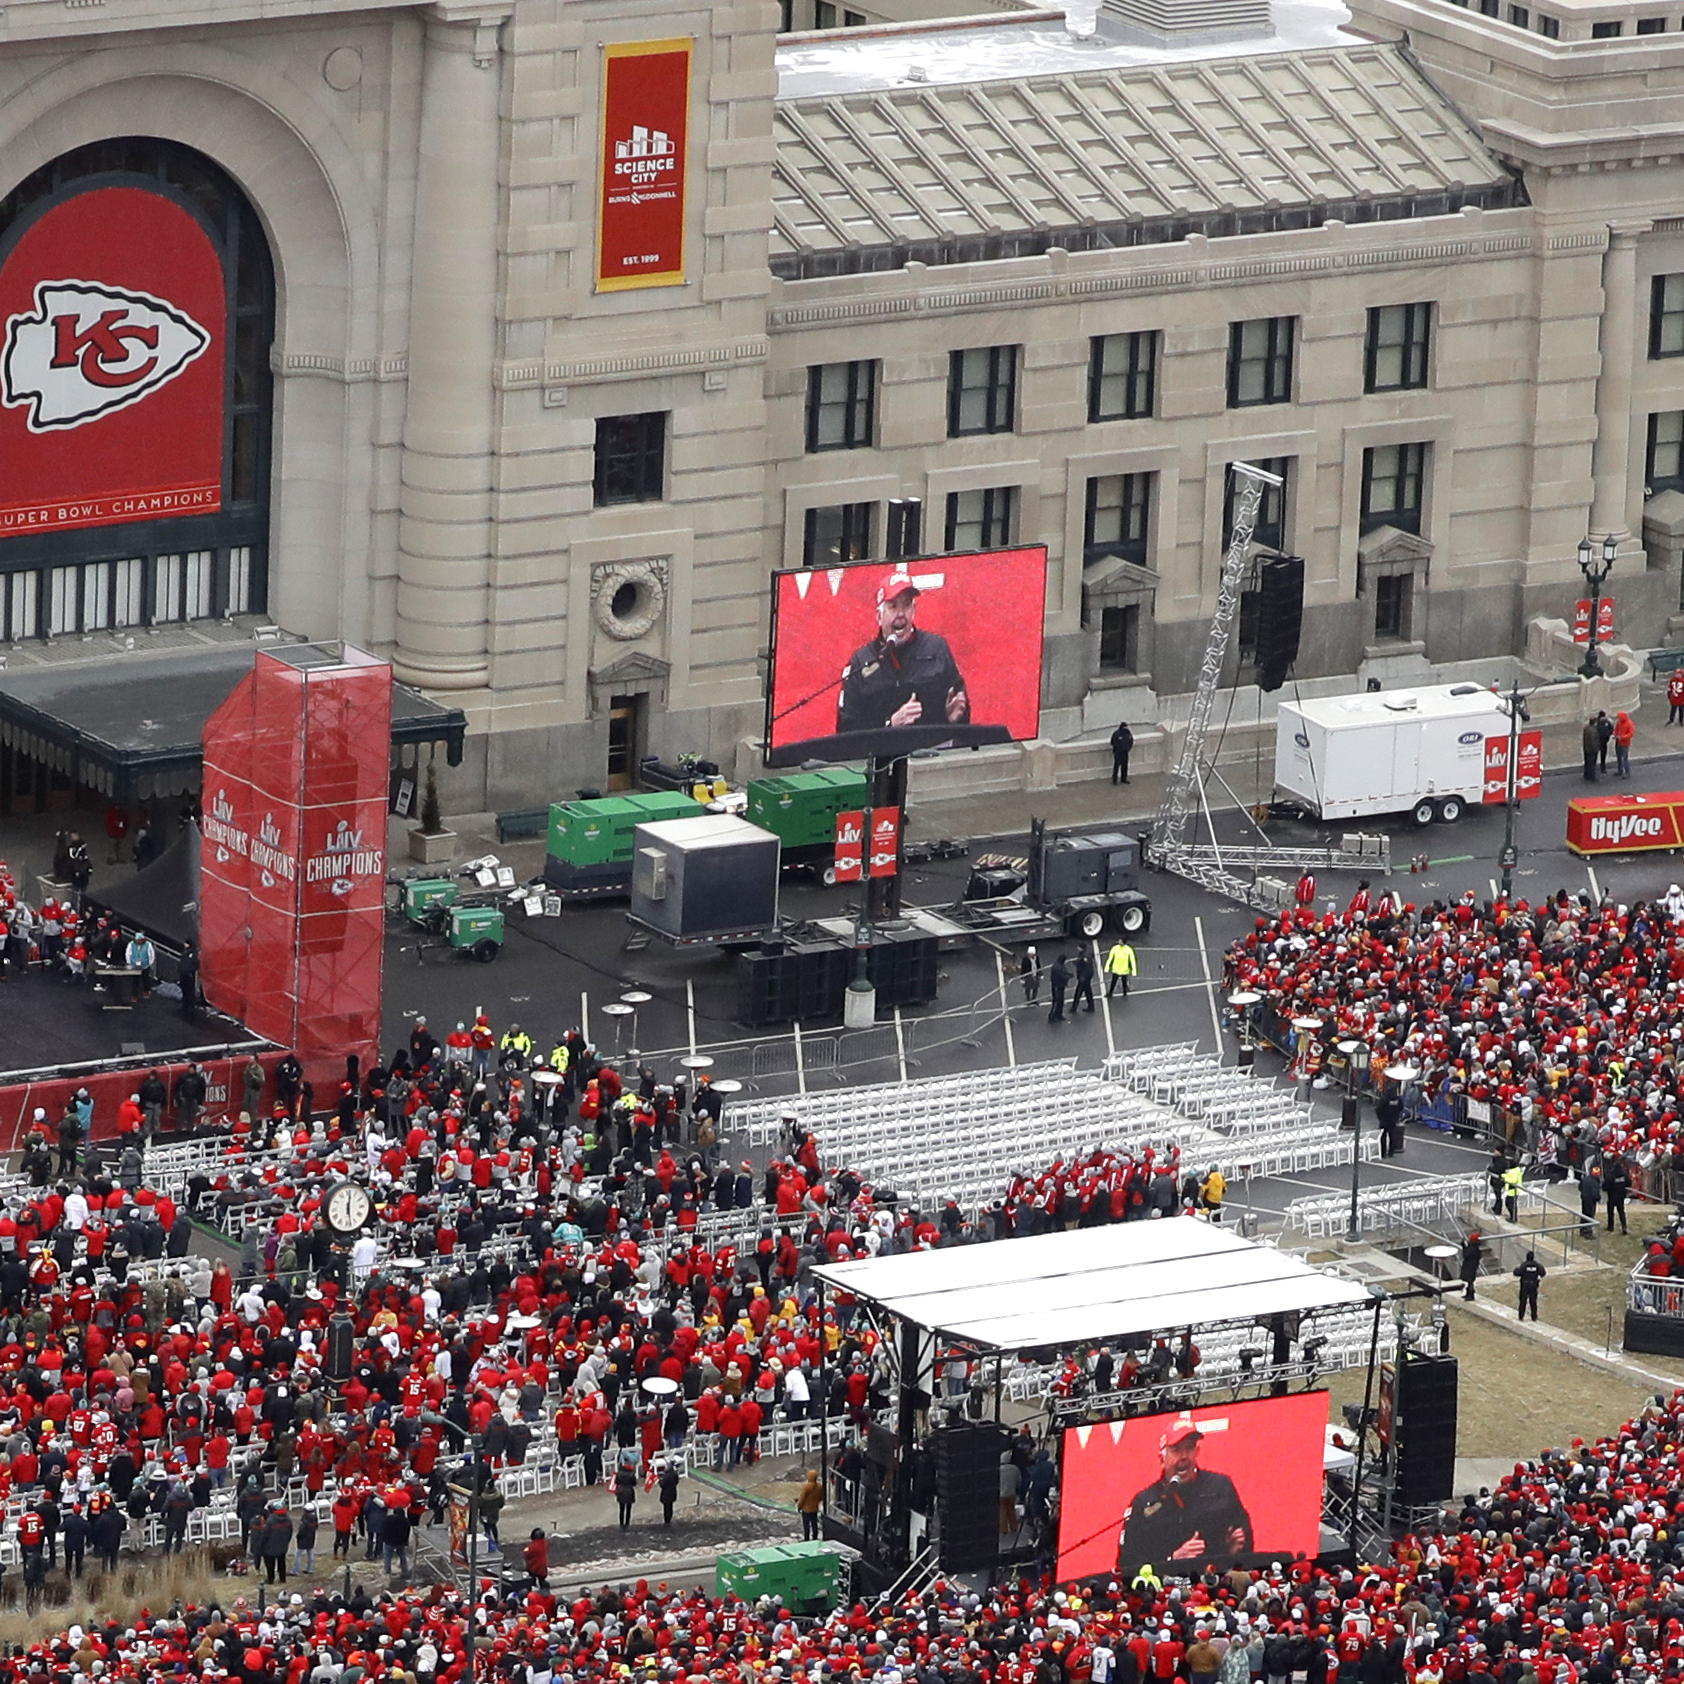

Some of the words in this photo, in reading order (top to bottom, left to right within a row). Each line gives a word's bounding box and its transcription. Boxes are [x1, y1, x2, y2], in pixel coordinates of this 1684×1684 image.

[615, 158, 674, 174] SCIENCE
[631, 172, 658, 183] CITY
[49, 309, 159, 388] KC
[58, 506, 103, 519] BOWL
[112, 491, 213, 513] CHAMPIONS
[307, 851, 382, 882] CHAMPIONS
